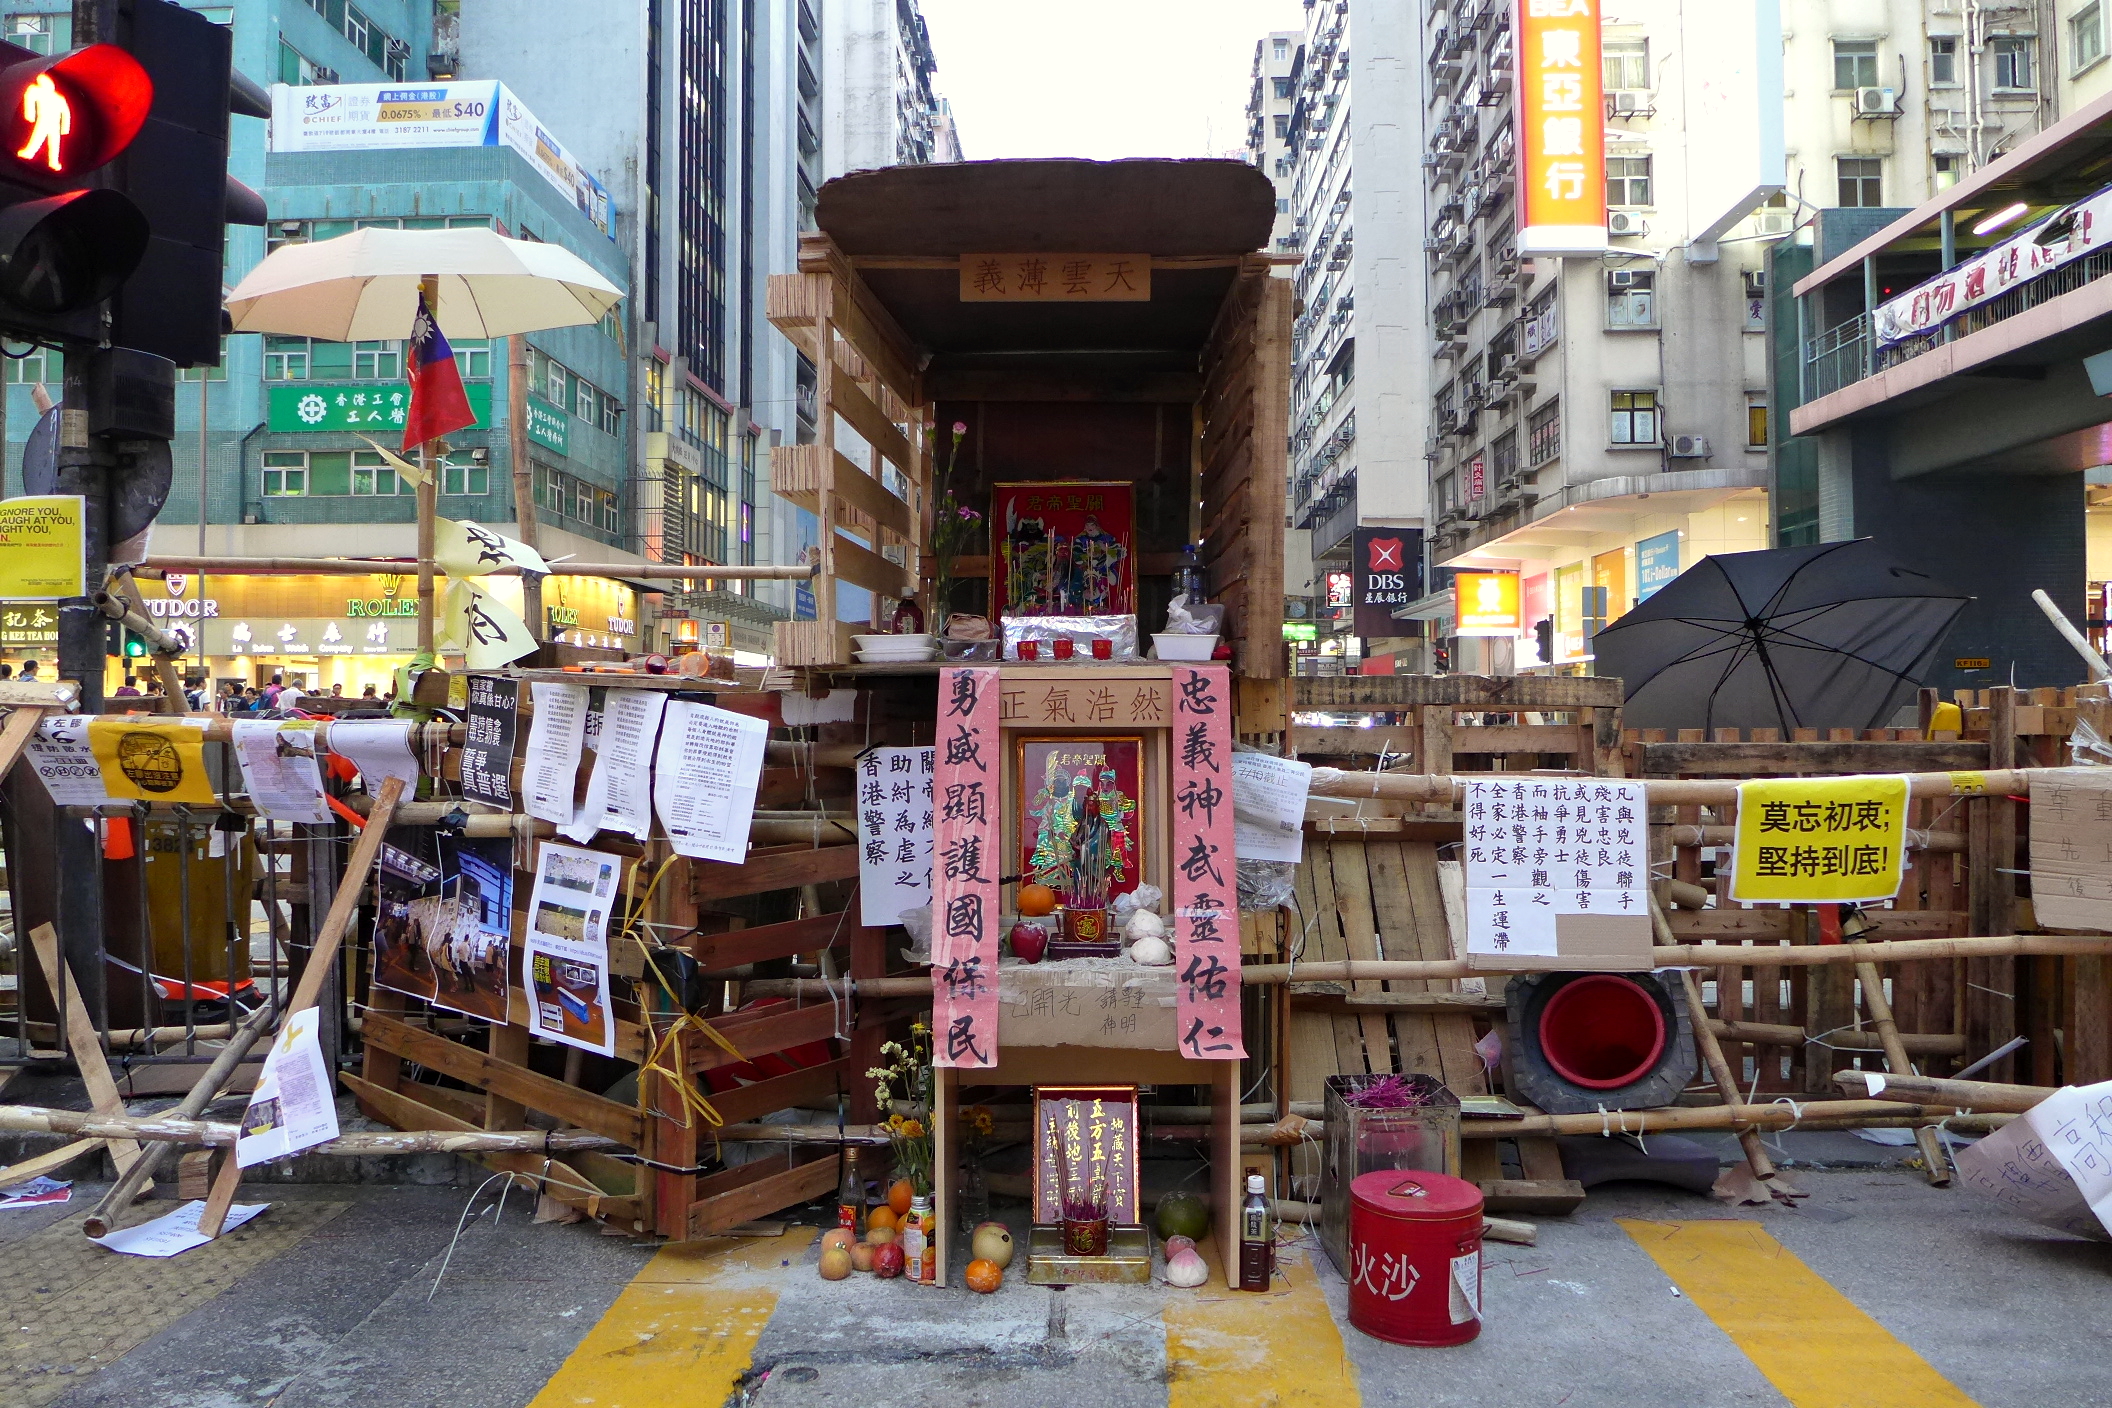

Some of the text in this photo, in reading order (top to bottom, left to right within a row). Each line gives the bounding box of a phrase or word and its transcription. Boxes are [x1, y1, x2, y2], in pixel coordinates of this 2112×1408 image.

[348, 96, 371, 107] 證券
[348, 111, 371, 122] 期貨
[381, 102, 485, 120] 0.0675% 最低 $40
[1541, 29, 1584, 199] 東亞銀行
[395, 126, 412, 134] 3187
[973, 258, 1137, 295] 義薄雲天
[335, 392, 403, 406] 香港工會
[26, 526, 51, 535] YOU,
[50, 516, 75, 526] YOU,
[1368, 574, 1404, 590] DBS
[4, 609, 58, 628] 記茶
[9, 631, 26, 640] KEE
[27, 631, 42, 640] TEA
[608, 616, 634, 634] TUDOR
[1001, 685, 1163, 723] 正氣浩然
[861, 752, 889, 866] 香港警察
[890, 754, 921, 888] 助紂為虐之
[1468, 782, 1487, 864] 不得好死
[1511, 783, 1529, 866] 香港警察
[1553, 784, 1571, 863] 抗爭勇士
[1594, 785, 1613, 867] 殘害忠良
[1760, 800, 1889, 832] 莫忘初衷;
[1531, 785, 1550, 906] 而袖手旁觀之
[1573, 783, 1592, 909] 或見兇徒傷害
[1615, 787, 1634, 910] 凡與兇徒聯手
[1756, 844, 1888, 878] 堅持到底!
[942, 669, 992, 1065] 勇威顯護國保民
[1490, 782, 1511, 952] 全家必定一生運滯
[1349, 1242, 1421, 1301] 火沙
